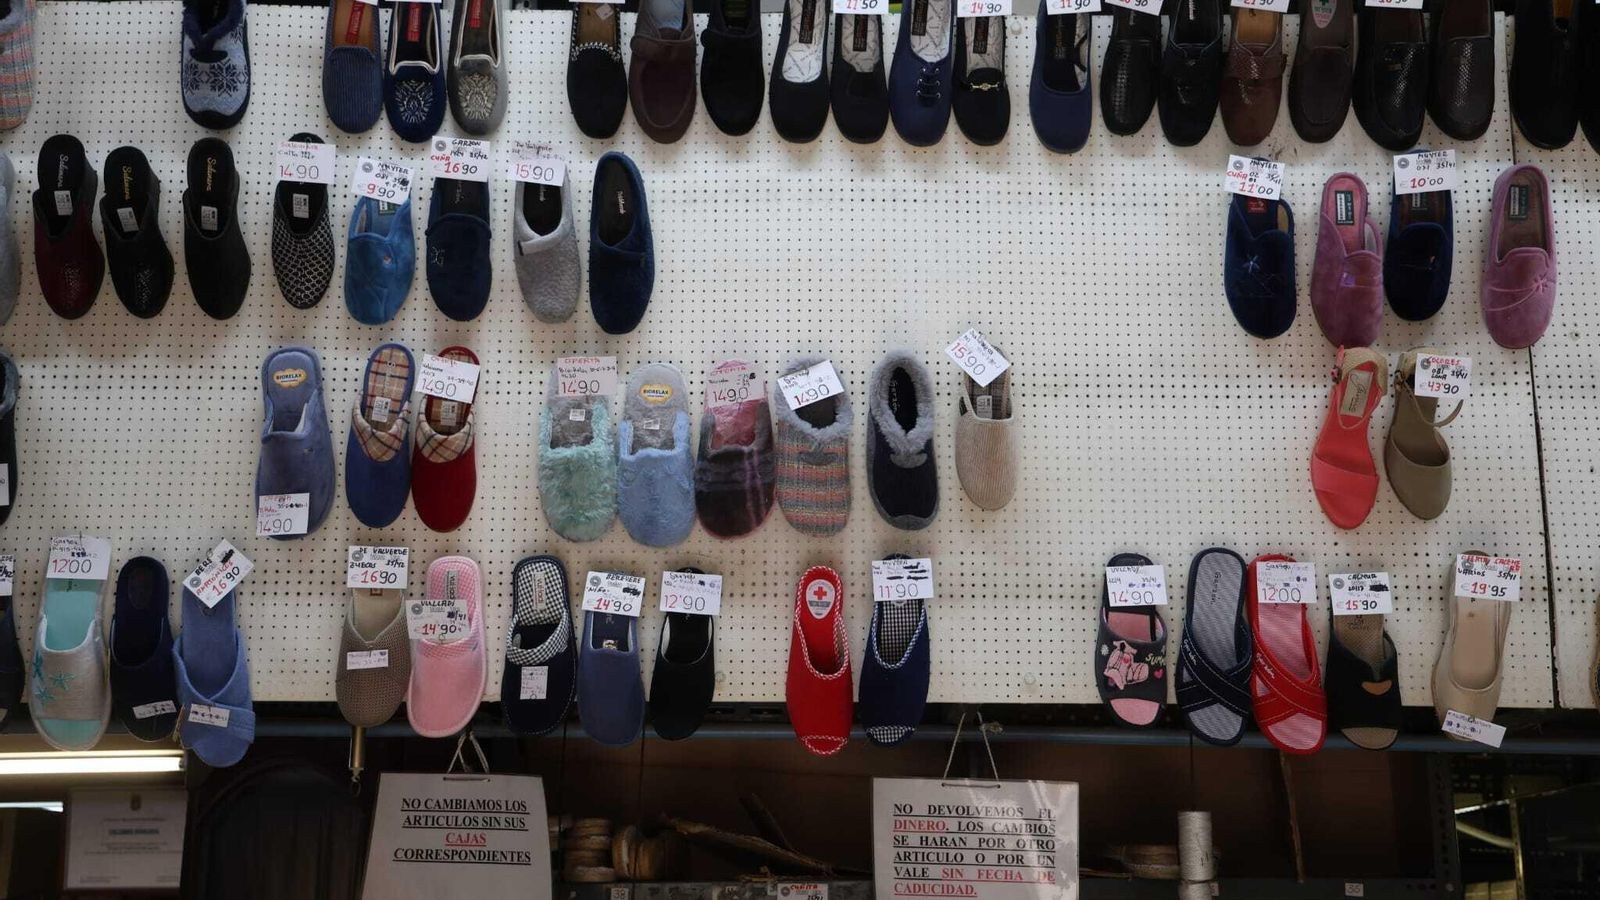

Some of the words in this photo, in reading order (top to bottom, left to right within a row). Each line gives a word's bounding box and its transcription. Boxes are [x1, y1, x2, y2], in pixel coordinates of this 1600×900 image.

[444, 162, 478, 175] 16'90
[516, 163, 554, 182] 15'90
[367, 183, 396, 198] 9'90
[1239, 182, 1274, 195] 11'00
[1410, 177, 1444, 189] 10'00
[1428, 382, 1459, 394] 43'90
[212, 566, 239, 596] 16'90
[360, 570, 397, 585] 16'90
[1471, 582, 1507, 597] 19'95
[594, 597, 632, 612] 14'90
[665, 594, 705, 611] 12'90
[1345, 599, 1377, 610] 15'90
[421, 624, 457, 635] 14'90
[401, 798, 421, 810] NO
[424, 798, 502, 811] CAMBIAMOS
[505, 800, 527, 812] LOS
[893, 804, 913, 815] NO
[927, 804, 1024, 818] DEVOLVEMOS
[1038, 808, 1056, 819] EL
[403, 815, 479, 827] ARTICULOS
[481, 816, 502, 827] SIN
[504, 817, 526, 829] SUS
[893, 819, 950, 832] DINERO.
[957, 820, 984, 832] LOS
[991, 822, 1056, 835] CAMBIOS
[445, 832, 486, 844] CAJAS
[893, 835, 909, 846] SE
[919, 836, 967, 847] HARAN
[978, 837, 1006, 849] POR
[1016, 838, 1056, 851] OTRO
[393, 848, 531, 863] CORRESPONDIENTES
[894, 851, 964, 863] ARTICULO
[975, 852, 985, 864] O
[996, 854, 1024, 865] POR
[1036, 854, 1055, 866] UN
[894, 867, 930, 878] VALE
[941, 868, 965, 879] SIN
[977, 869, 1024, 881] FECHA
[1036, 870, 1056, 882] DE
[894, 882, 977, 895] CADUCIDAD.
